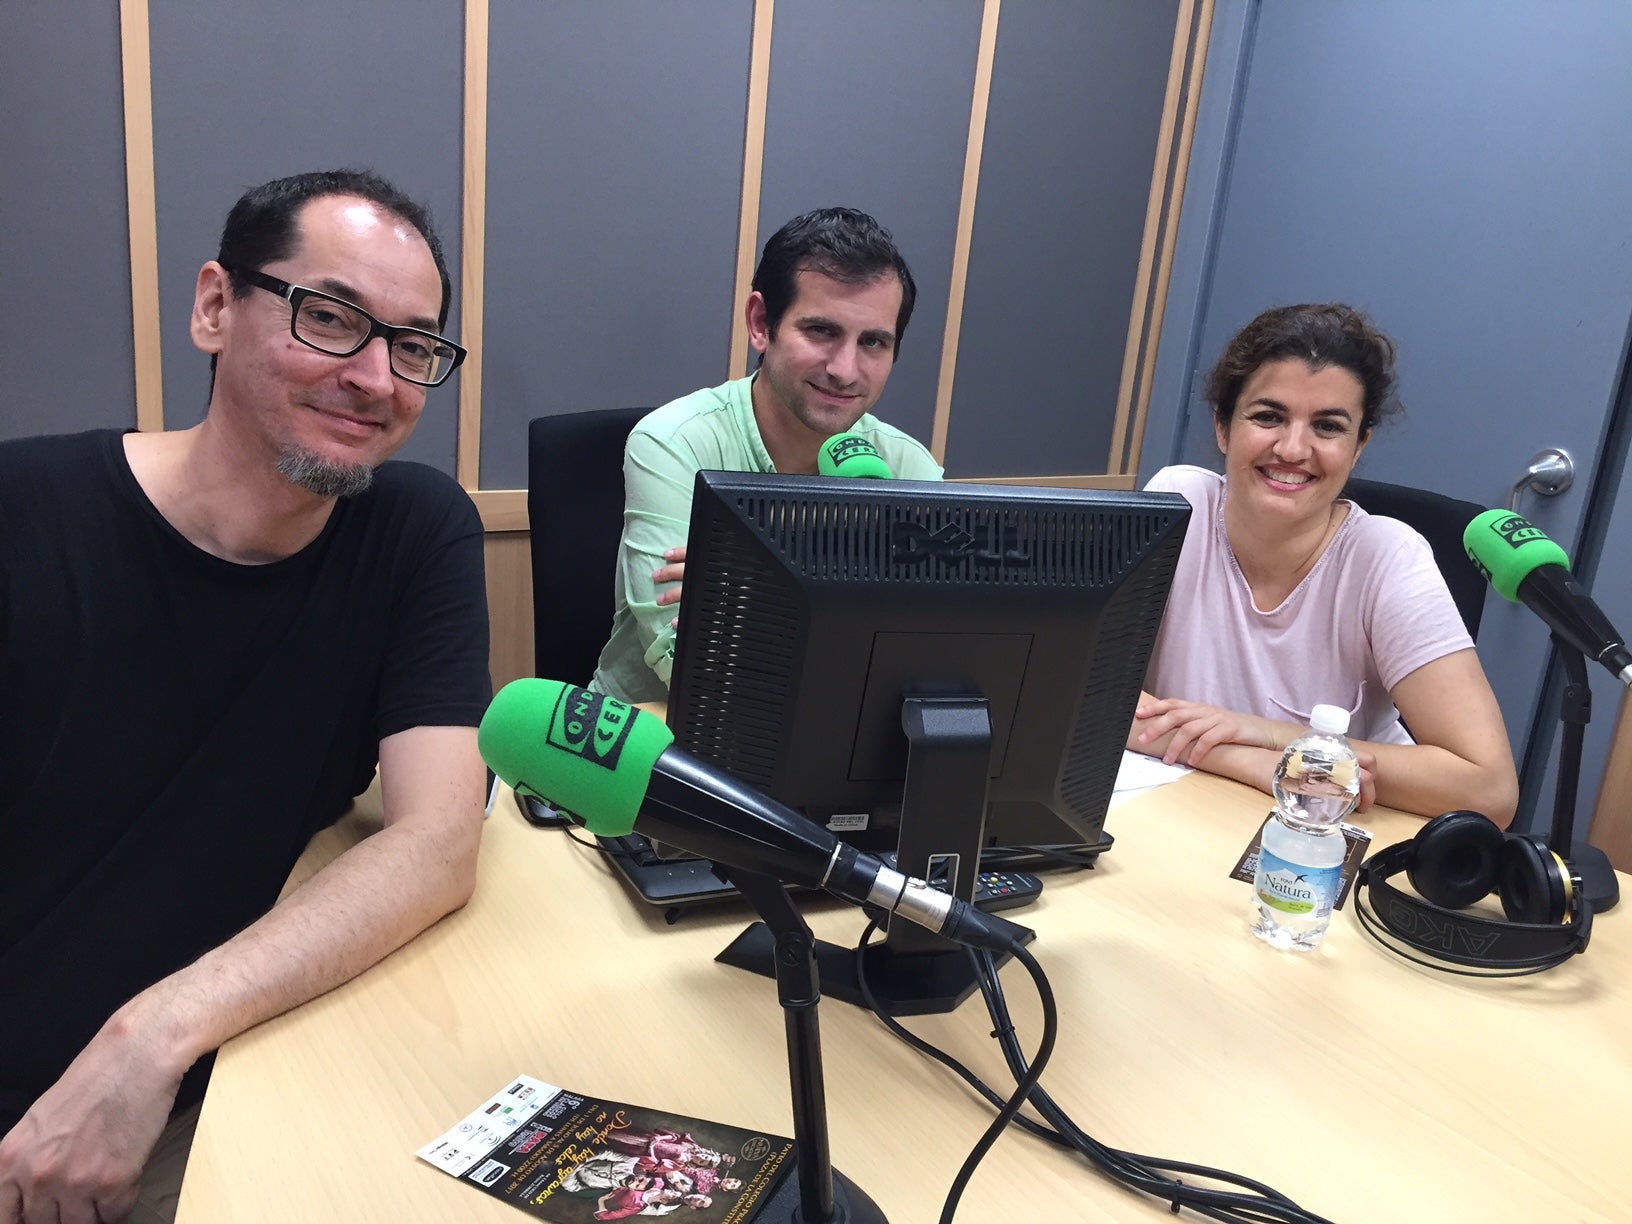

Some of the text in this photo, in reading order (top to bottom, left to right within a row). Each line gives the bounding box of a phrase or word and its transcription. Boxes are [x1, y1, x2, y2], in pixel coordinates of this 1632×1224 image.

[891, 520, 1032, 568] DELL
[1264, 873, 1311, 900] Natura
[1389, 899, 1501, 956] AKG
[555, 1111, 607, 1165] no hay celos
[592, 1110, 632, 1145] Donde
[571, 1147, 595, 1164] hay
[759, 1151, 778, 1174] (PLAZA
[776, 1143, 793, 1164] PATIO
[752, 1174, 762, 1184] DE
[766, 1164, 779, 1176] DEL
[745, 1184, 755, 1194] LA
[745, 1177, 770, 1208] COLEGIO
